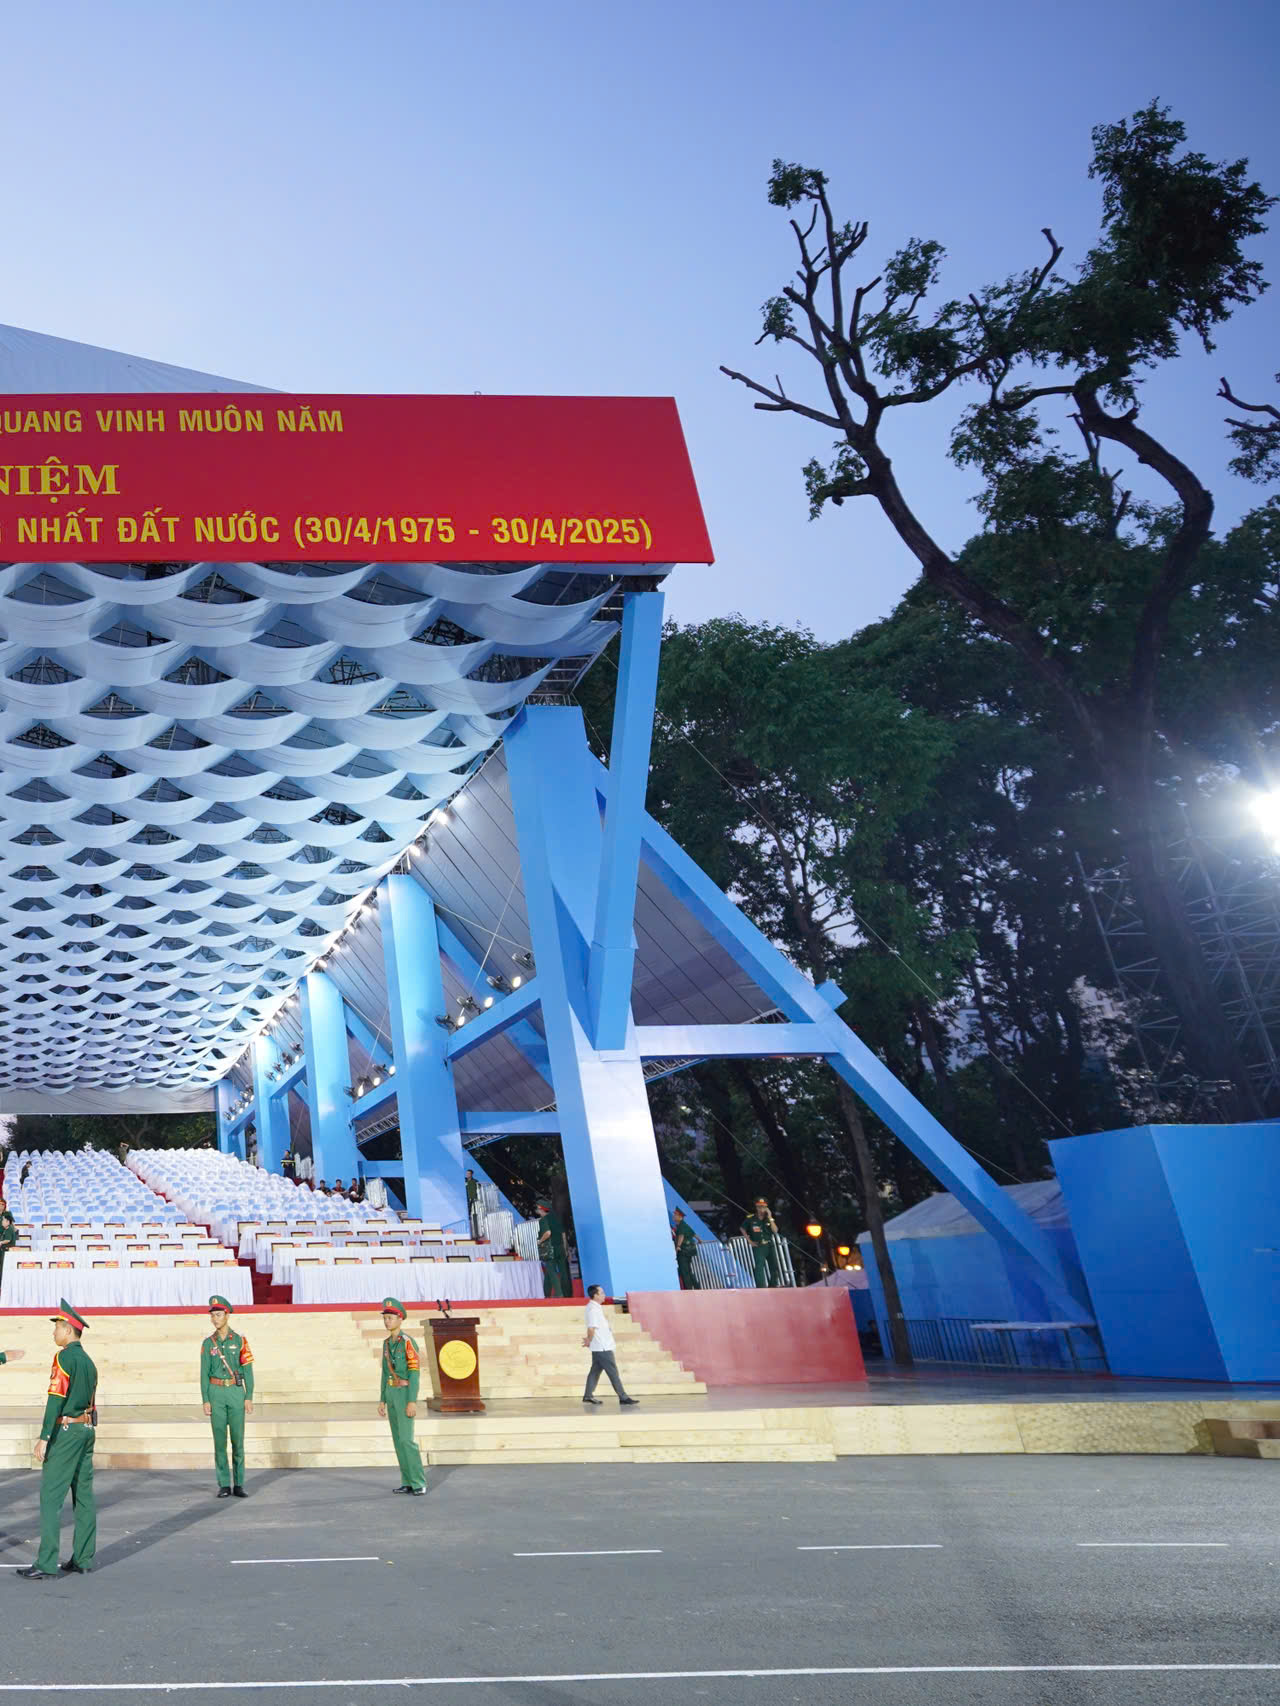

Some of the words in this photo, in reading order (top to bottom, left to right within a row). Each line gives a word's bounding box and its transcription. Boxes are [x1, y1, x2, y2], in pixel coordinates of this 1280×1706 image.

[94, 410, 166, 433] VINH
[177, 404, 265, 433] MUÔN
[276, 405, 345, 433] NĂM
[17, 507, 105, 543] NHẤT
[116, 507, 181, 543] ĐẤT
[193, 510, 281, 543] NƯỚC
[293, 516, 457, 549] (30/4/1975
[490, 517, 653, 551] 30/4/2025)
